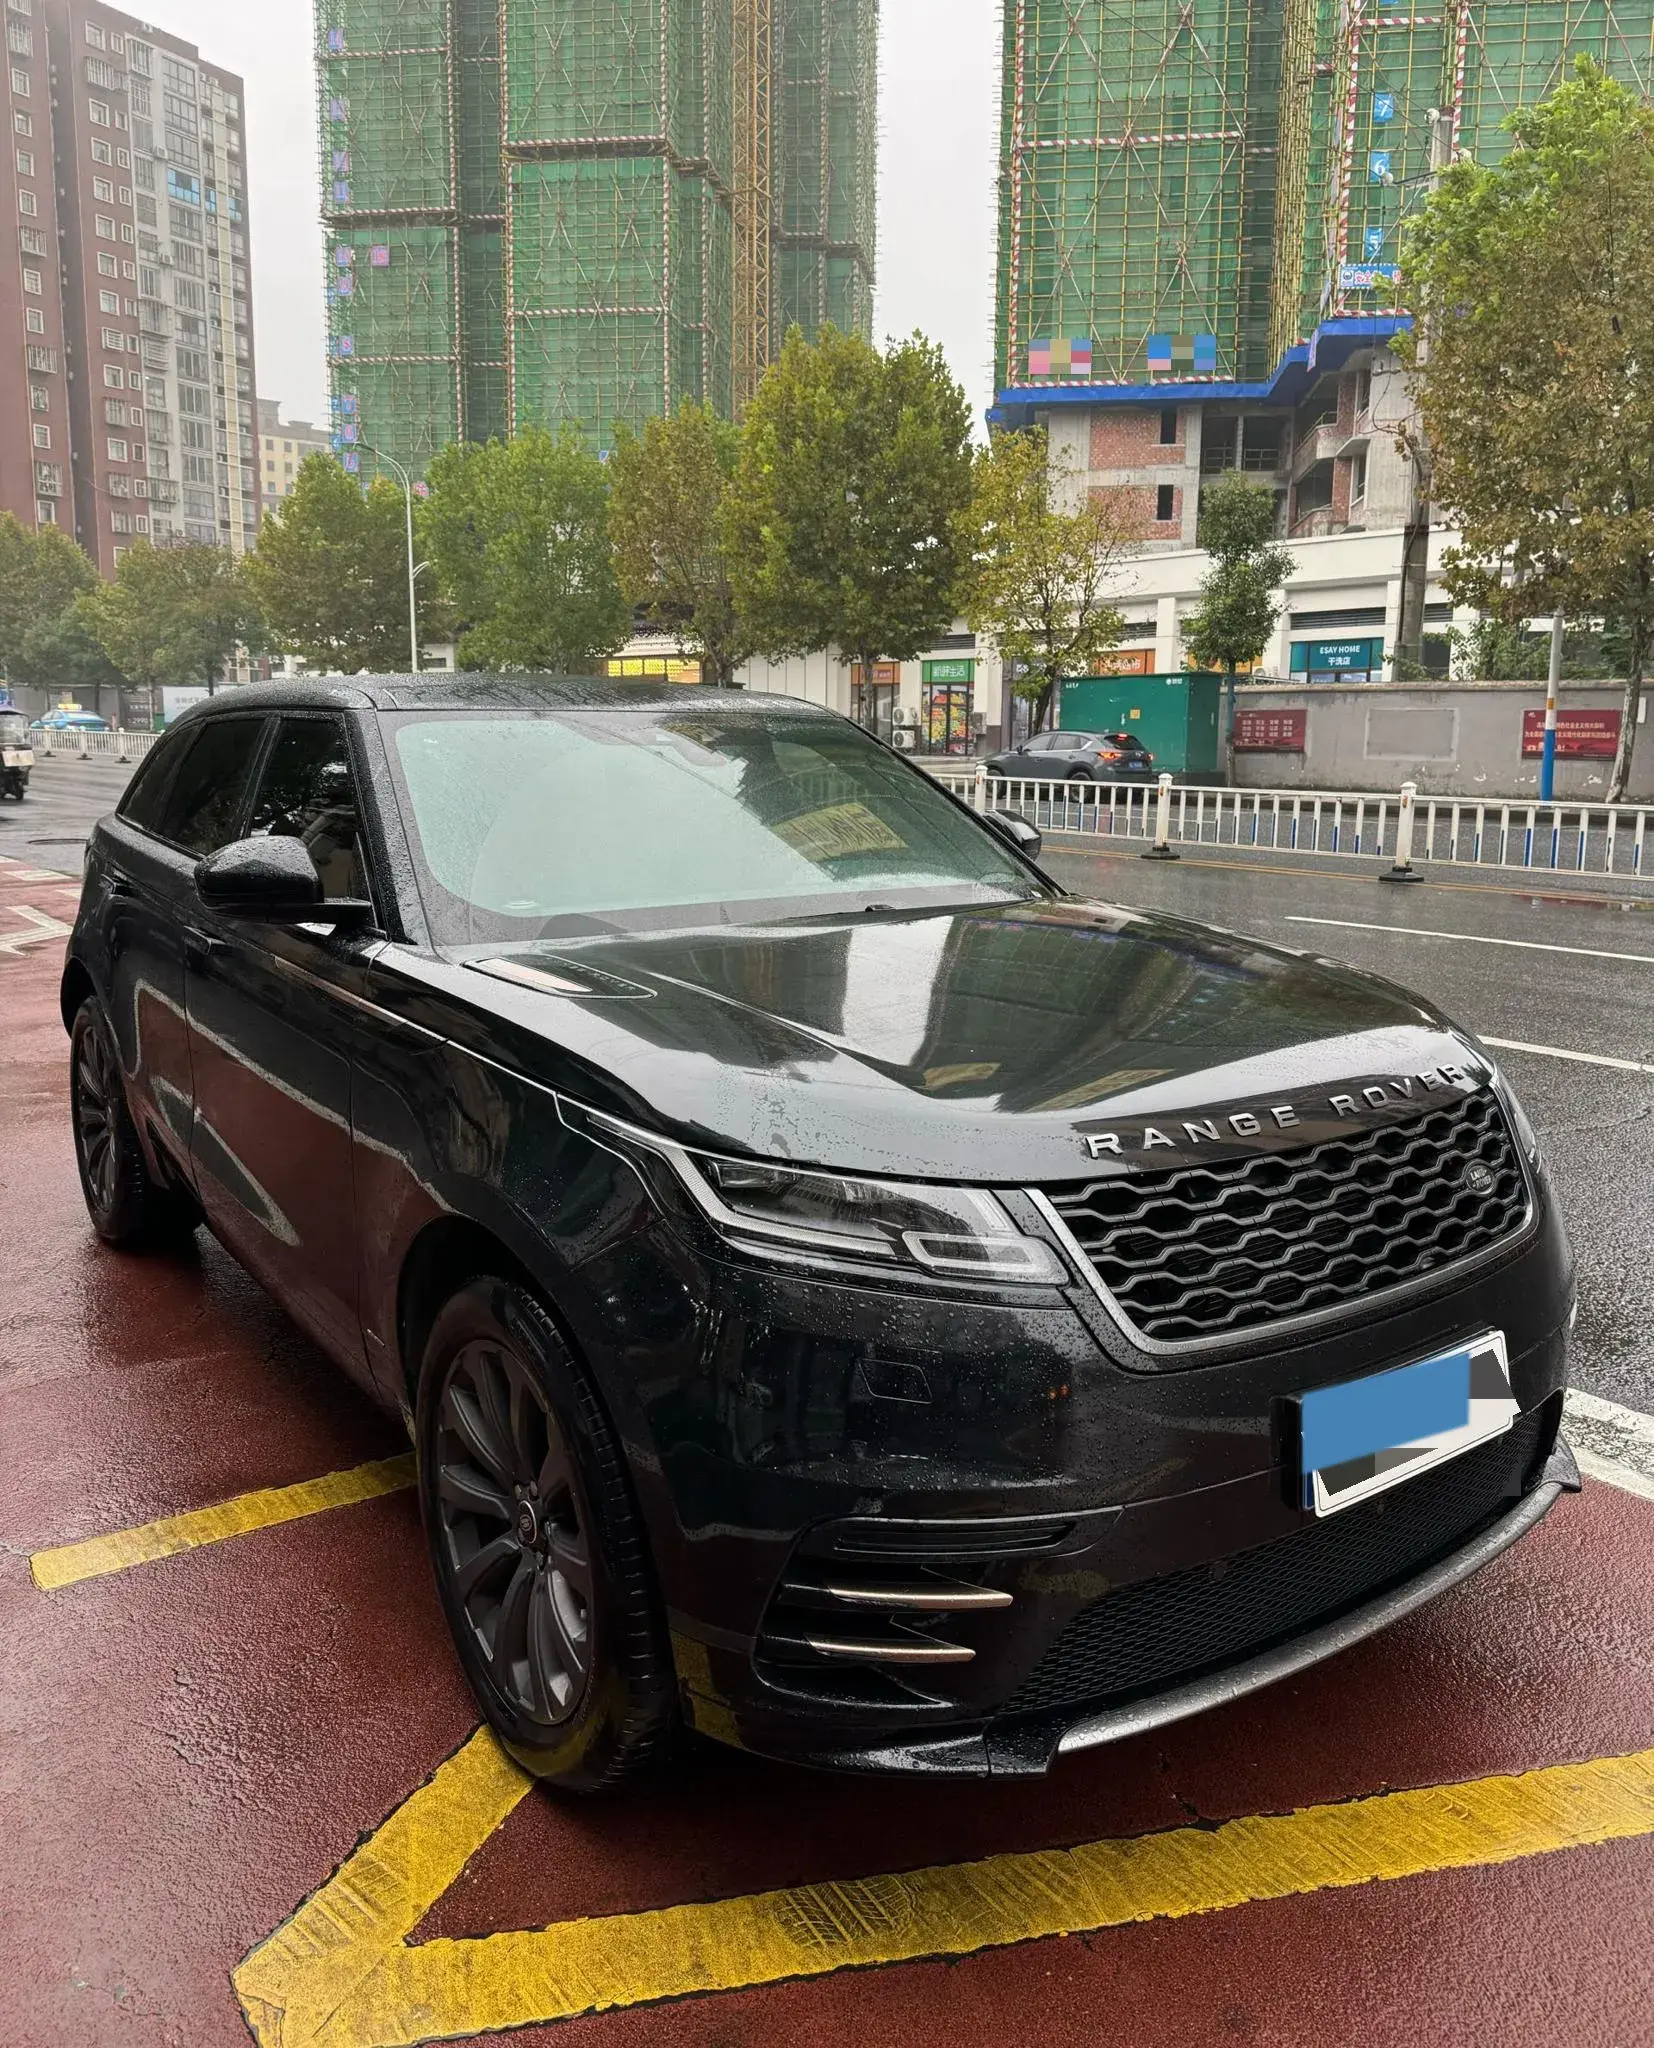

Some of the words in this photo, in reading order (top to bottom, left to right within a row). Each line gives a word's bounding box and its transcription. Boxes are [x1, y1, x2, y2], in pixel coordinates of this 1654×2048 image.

[1378, 98, 1390, 117] 7
[1373, 159, 1386, 175] 6
[1320, 646, 1337, 654] ESAY
[1338, 645, 1360, 653] HOME
[1328, 656, 1351, 666] 干洗店
[1085, 1104, 1302, 1158] RANGE
[1328, 1062, 1466, 1117] ROVER
